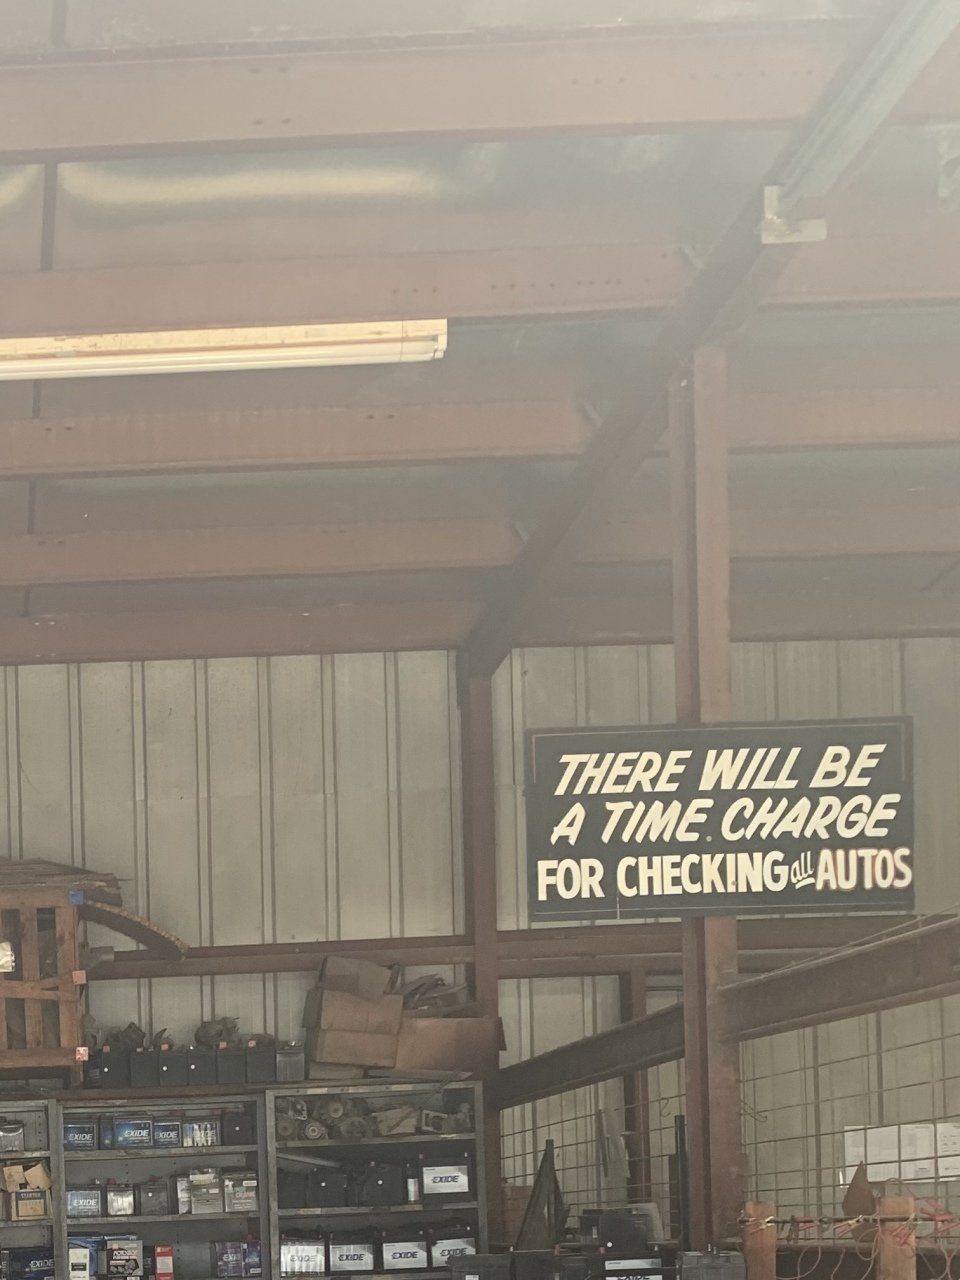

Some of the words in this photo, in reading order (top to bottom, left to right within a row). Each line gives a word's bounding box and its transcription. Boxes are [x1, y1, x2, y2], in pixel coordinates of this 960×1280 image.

[553, 749, 693, 796] THERE
[699, 743, 803, 792] WILL
[809, 743, 887, 790] BE
[550, 801, 587, 846] A
[600, 798, 714, 844] TIME
[720, 793, 902, 842] CHARGE
[537, 857, 606, 901] FOR
[616, 848, 790, 898] CHECKING
[790, 850, 816, 889] all
[814, 847, 913, 891] AUTOS
[124, 1129, 149, 1138] EXIDE
[432, 1175, 459, 1184] EXIDE
[338, 1253, 365, 1262] EXIDE
[391, 1251, 418, 1260] EXIDE
[29, 1259, 55, 1269] EXIDE
